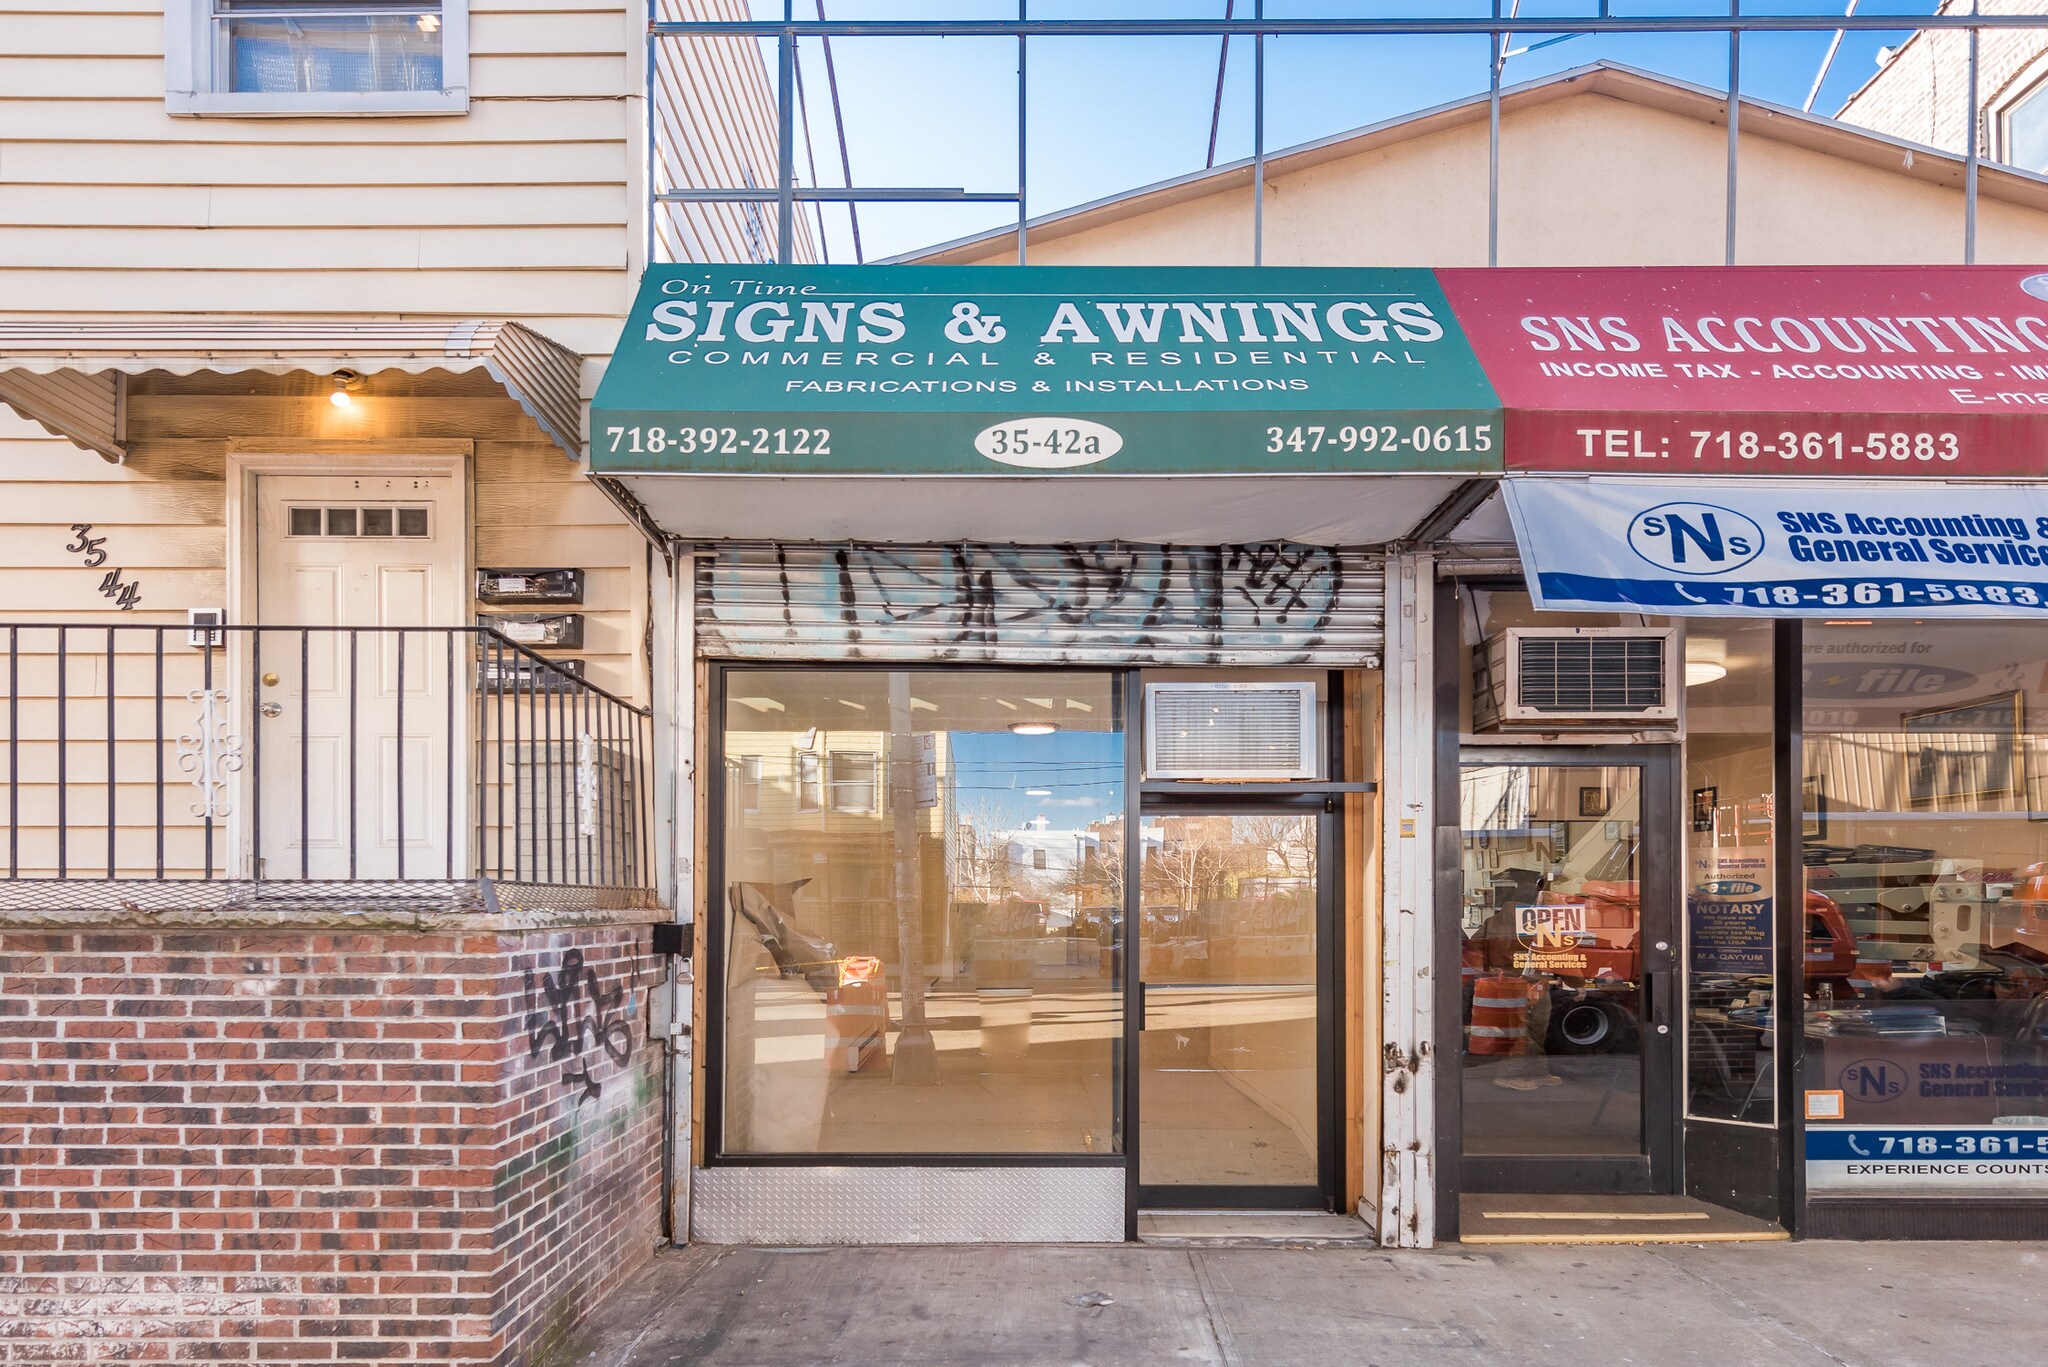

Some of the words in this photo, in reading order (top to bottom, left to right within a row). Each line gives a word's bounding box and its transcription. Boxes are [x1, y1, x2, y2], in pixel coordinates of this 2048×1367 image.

[661, 279, 712, 295] On
[730, 280, 818, 296] Time
[645, 300, 907, 344] SIGNS
[944, 301, 1007, 344] &
[1040, 301, 1445, 344] AWNINGS
[1520, 316, 1642, 352] SNS
[668, 350, 1000, 366] COMMERCIAL
[1034, 351, 1056, 366] &
[1091, 350, 1426, 365] RESIDENTIAL
[1539, 362, 1668, 378] INCOME
[1674, 363, 1741, 379] TAX
[1772, 364, 1982, 381] ACCOUNTING
[785, 380, 1018, 393] FABRICATIONS
[1031, 380, 1051, 392] &
[1066, 379, 1309, 392] INSTALLATIONS
[606, 427, 831, 455] 718-392-2122
[991, 428, 1101, 455] 35-42a
[1267, 424, 1493, 453] 347-992-0615
[1577, 430, 1670, 459] TEL:
[1690, 431, 1961, 461] 718-361-5883
[1777, 511, 1843, 534] SNS
[1845, 513, 2030, 541] Accounting
[1789, 535, 1930, 562] General
[1826, 641, 1908, 654] authorized
[1910, 641, 1934, 654] for
[1856, 669, 1947, 692] file
[1704, 872, 1756, 880] Authorized
[1730, 883, 1754, 893] file
[1696, 903, 1765, 915] NOTARY
[1521, 908, 1581, 932] OPEN
[1513, 952, 1531, 961] SNS
[1531, 953, 1579, 962] Accounting
[1580, 953, 1587, 961] &
[1513, 961, 1548, 969] General
[1548, 961, 1588, 969] Services
[1719, 953, 1763, 961] QAYYUM
[1919, 1063, 1952, 1079] SNS
[1919, 1080, 1990, 1097] General
[1847, 1164, 1969, 1175] EXPERIENCE
